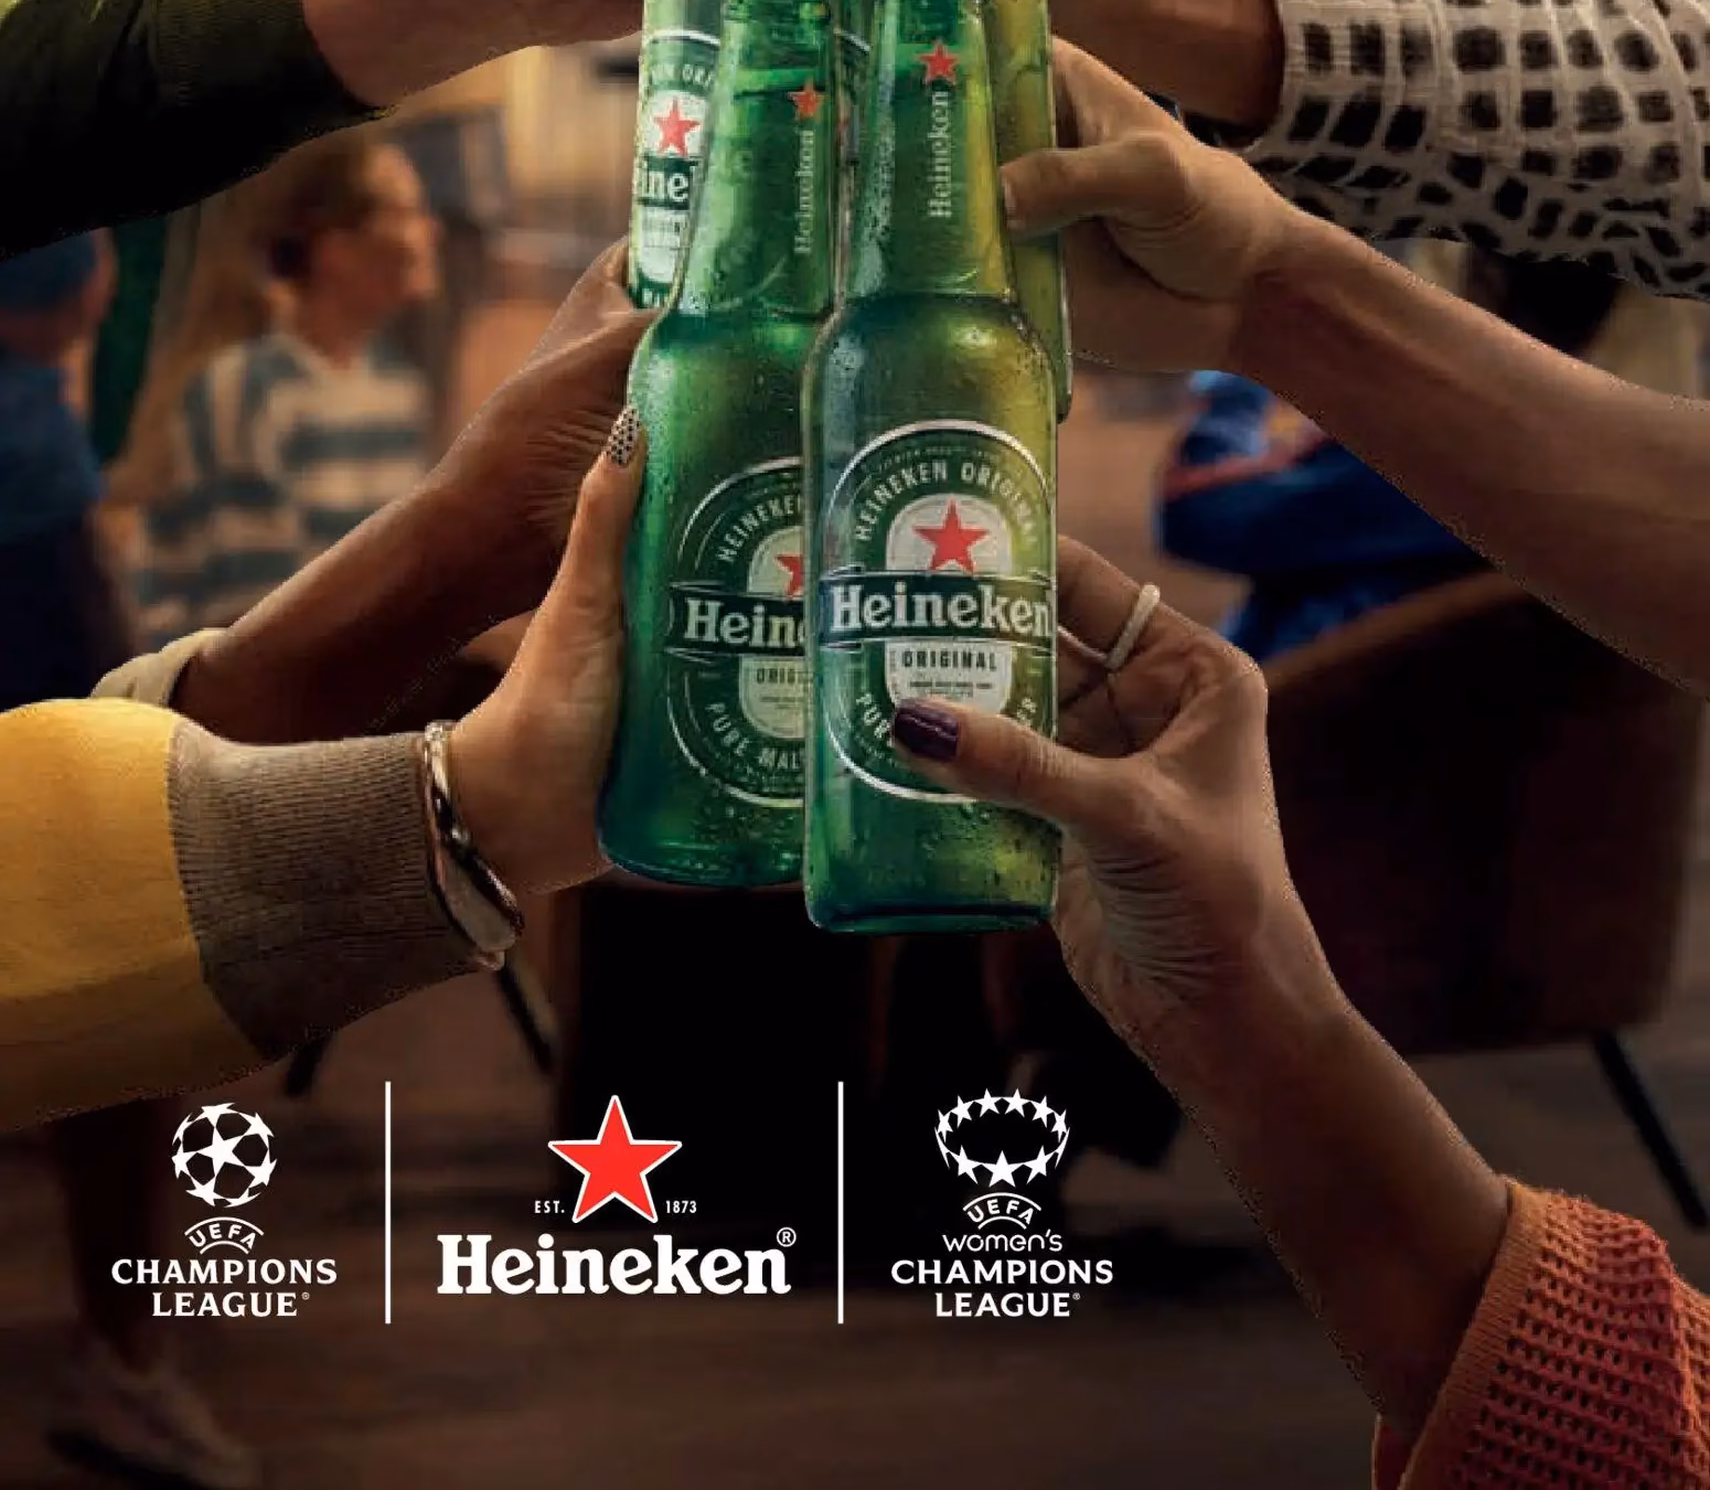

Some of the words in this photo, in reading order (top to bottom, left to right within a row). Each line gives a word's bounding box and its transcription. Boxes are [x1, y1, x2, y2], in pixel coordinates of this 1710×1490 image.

[926, 91, 952, 218] Heineken
[715, 494, 802, 563] HEINEKE
[830, 581, 1050, 637] Heineken
[904, 649, 997, 670] ORIGINAL
[758, 746, 803, 770] MAL
[534, 1200, 566, 1214] EST.
[665, 1200, 698, 1214] 1873
[966, 1198, 1035, 1225] UEFA
[188, 1223, 257, 1250] UEFA
[111, 1258, 337, 1285] CHAMPIONS
[891, 1259, 1114, 1285] CHAMPIONS
